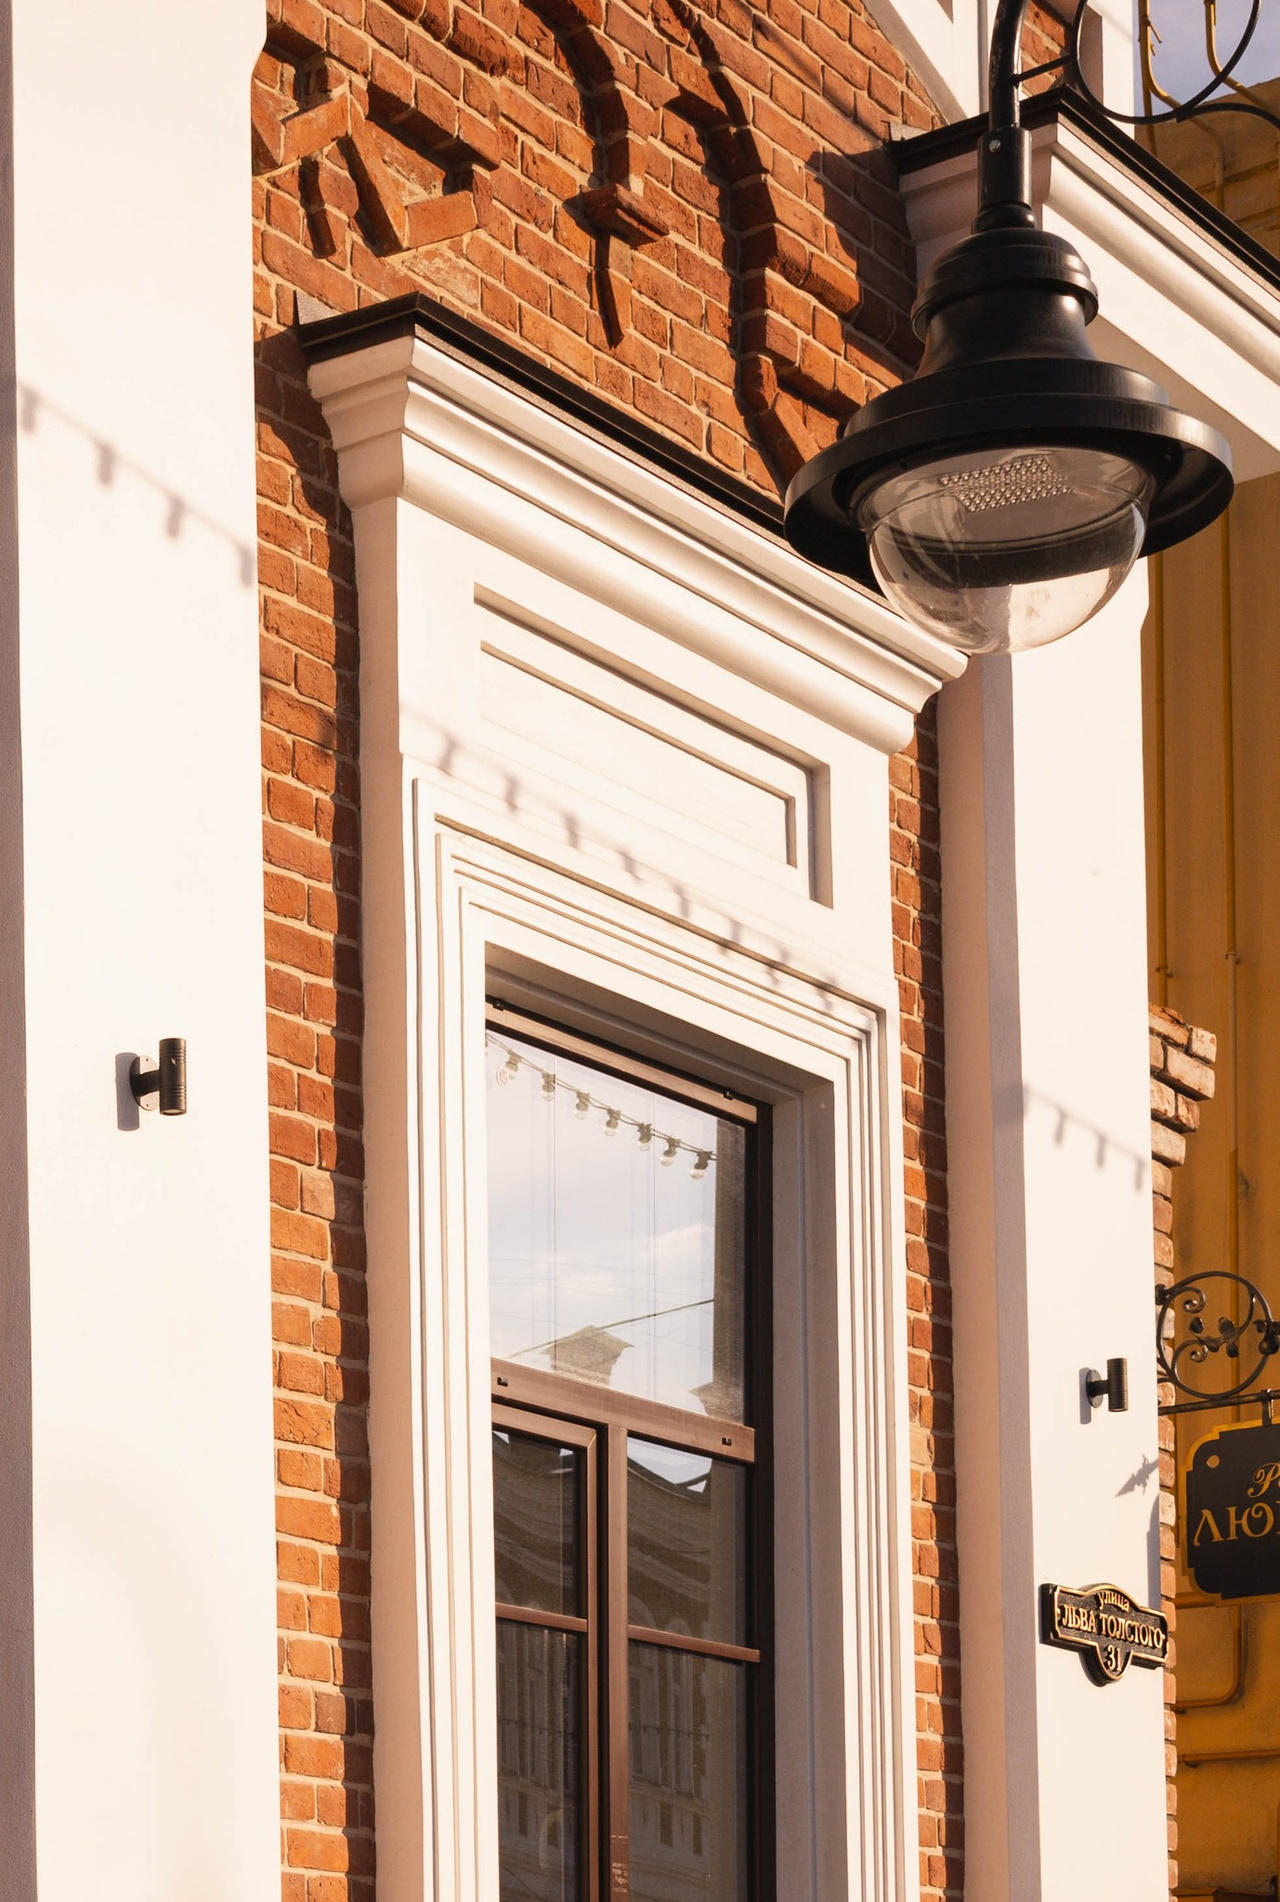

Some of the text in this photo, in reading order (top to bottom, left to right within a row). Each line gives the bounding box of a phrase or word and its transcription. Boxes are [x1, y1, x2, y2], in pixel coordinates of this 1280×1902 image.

[1193, 1500, 1280, 1546] ЛЮ
[1098, 1591, 1130, 1612] улица
[1062, 1604, 1163, 1649] ЛЬВА ТОЛСТОГО
[1107, 1644, 1123, 1672] 31
